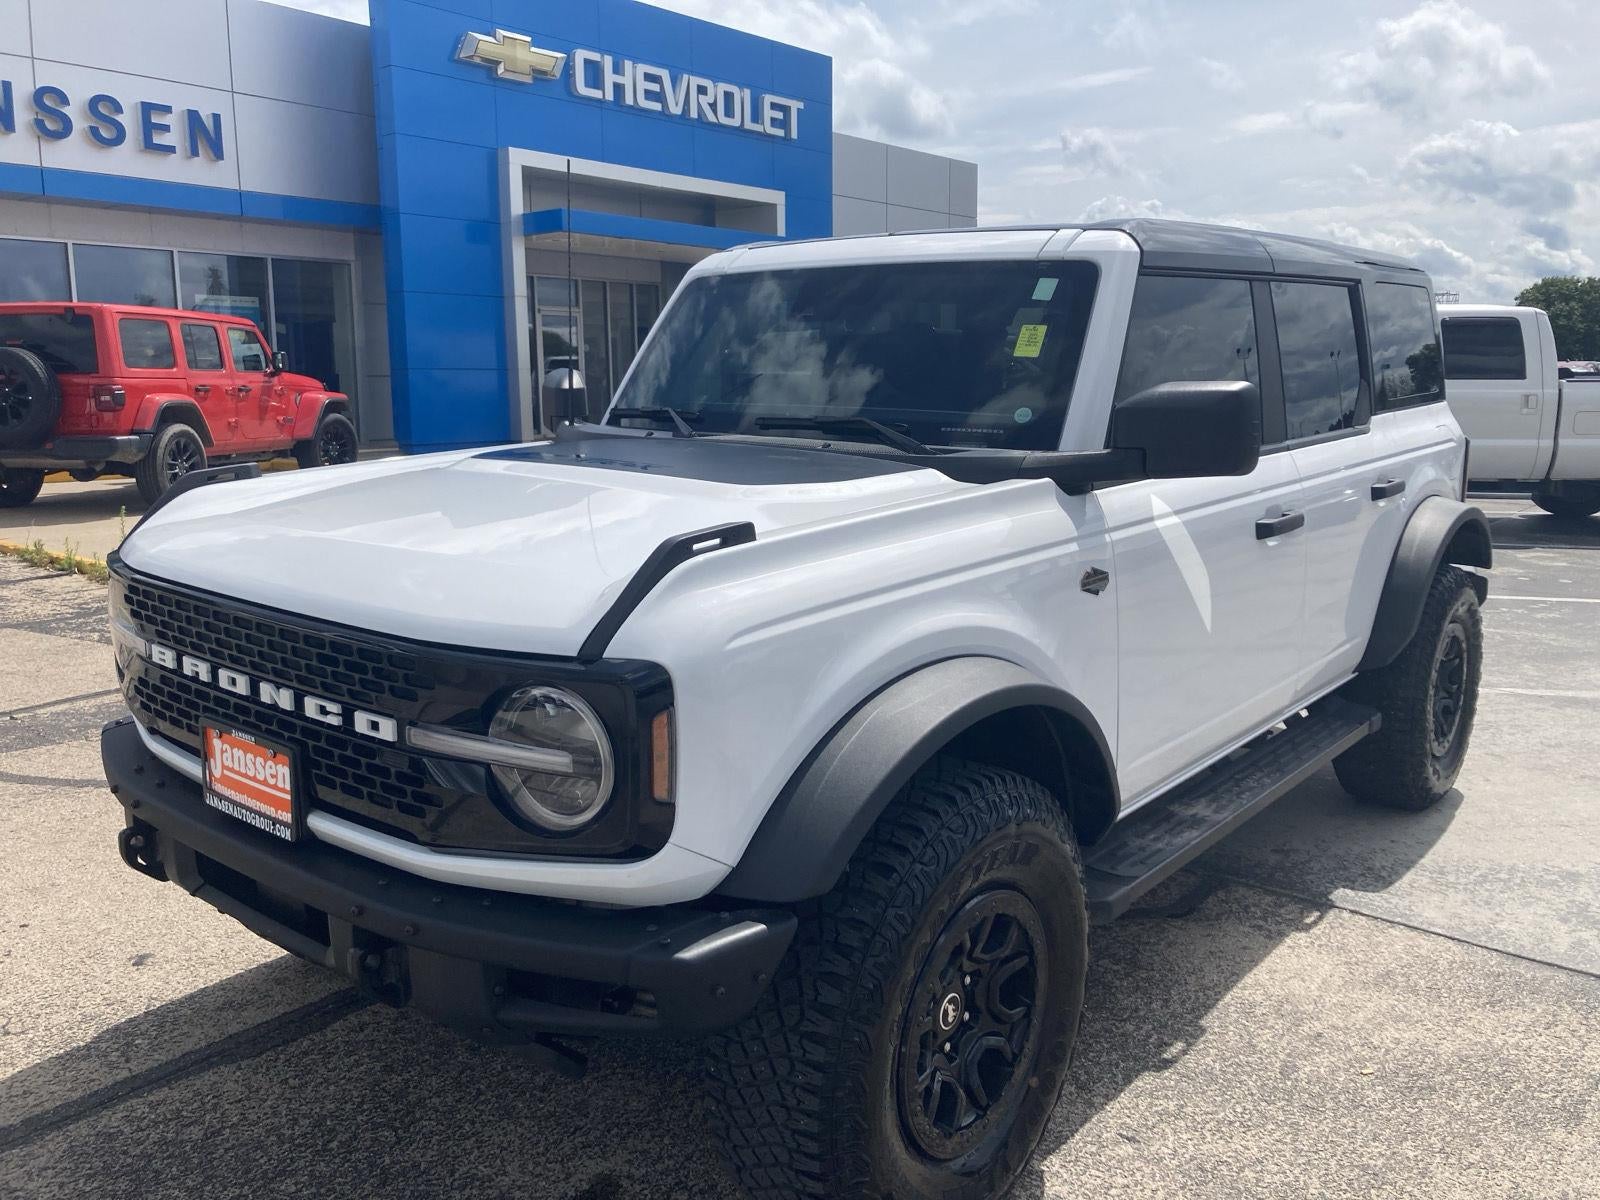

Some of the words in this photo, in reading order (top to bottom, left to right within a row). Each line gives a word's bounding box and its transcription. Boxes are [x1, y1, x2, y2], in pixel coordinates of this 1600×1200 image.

[571, 48, 804, 140] CHEVROLET
[151, 643, 398, 742] BRONCO
[205, 793, 292, 841] JANSSENAUTOGROUP.COM
